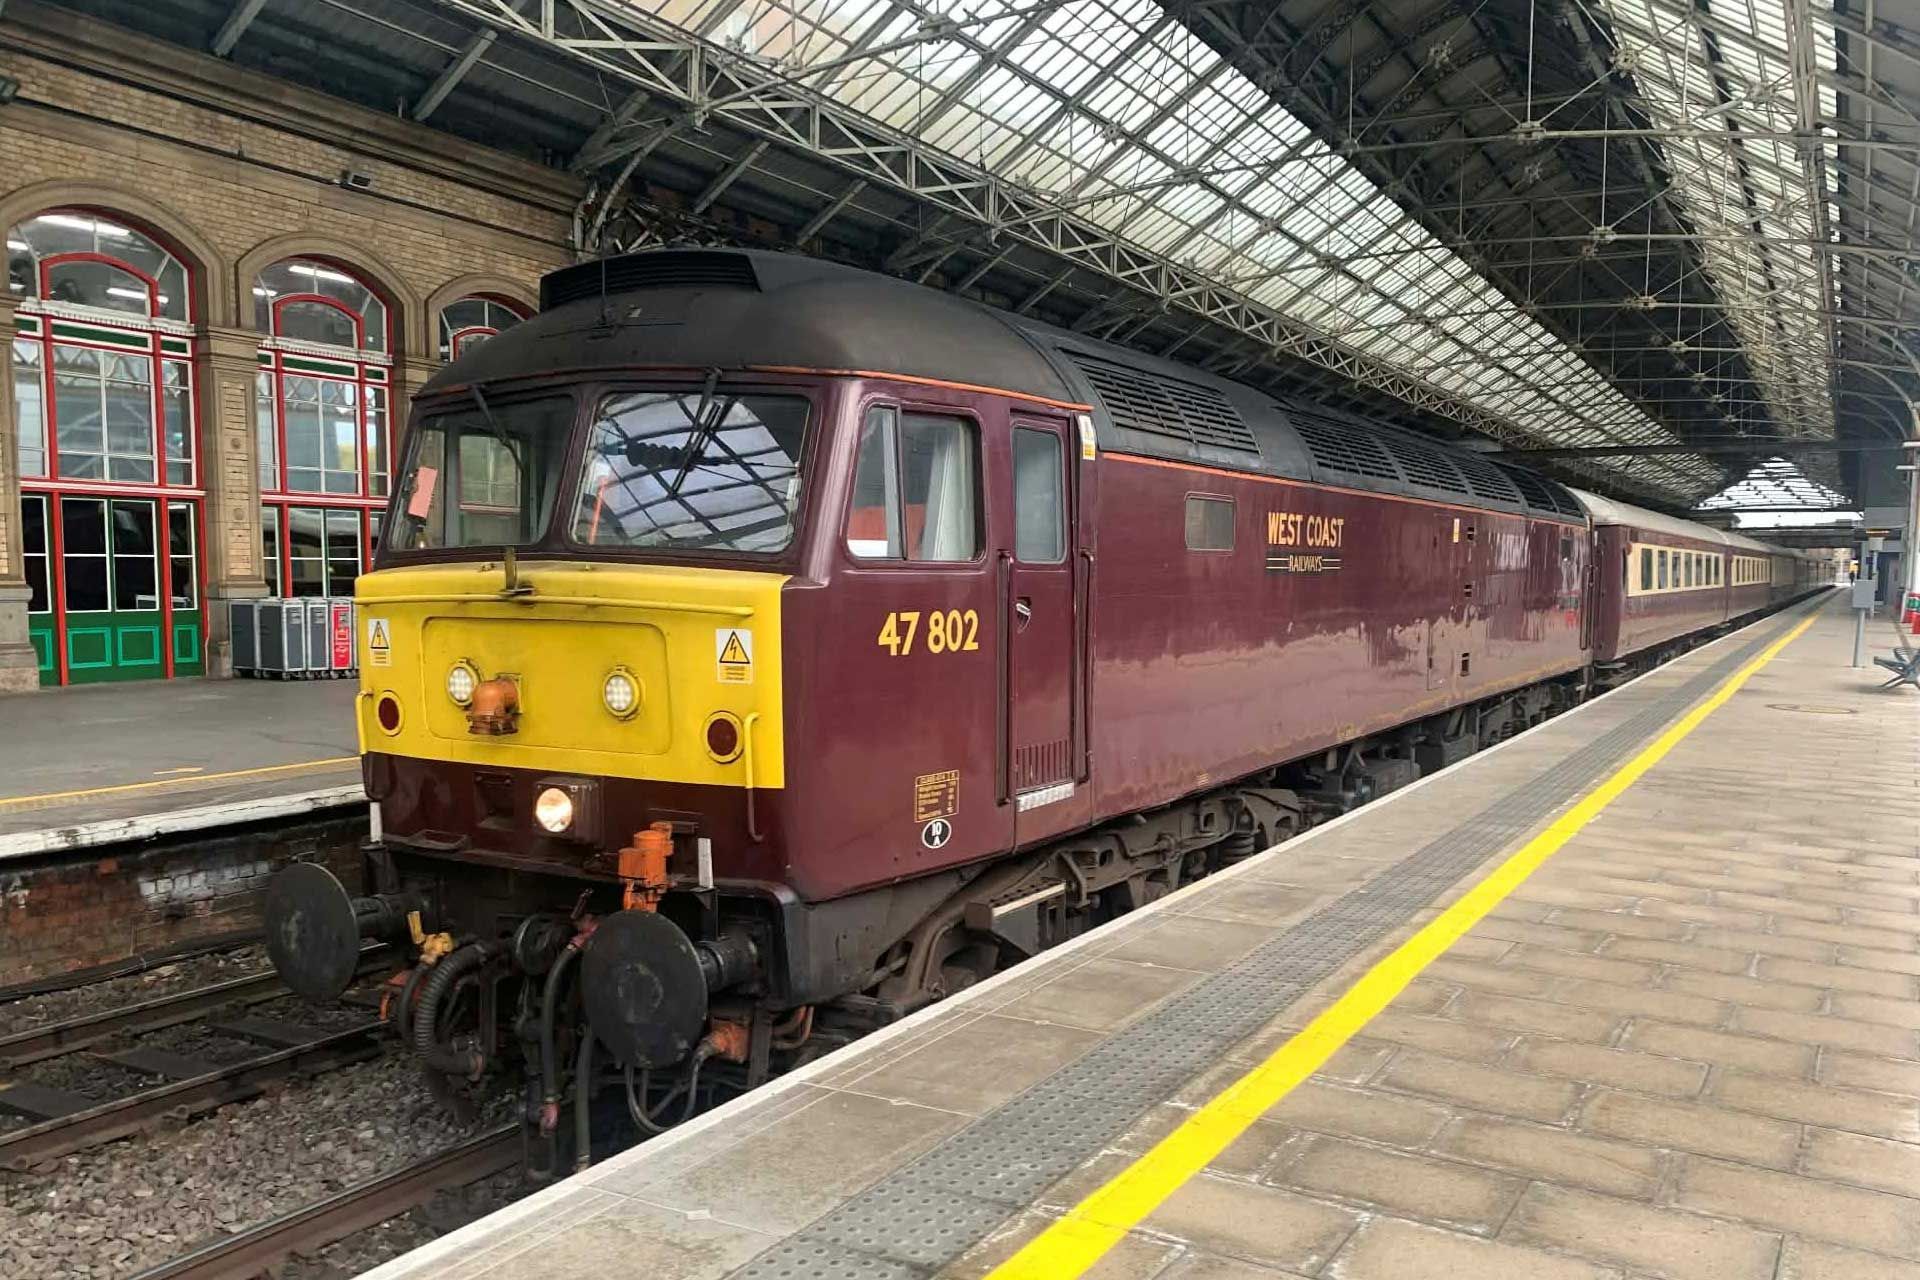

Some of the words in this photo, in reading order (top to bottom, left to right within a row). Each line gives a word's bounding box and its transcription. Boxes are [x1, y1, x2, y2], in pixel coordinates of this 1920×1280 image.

[1268, 511, 1303, 545] WEST
[1306, 515, 1344, 547] COAST
[1289, 554, 1322, 571] RAILWAYS
[878, 611, 920, 656] 47
[927, 609, 979, 653] 802
